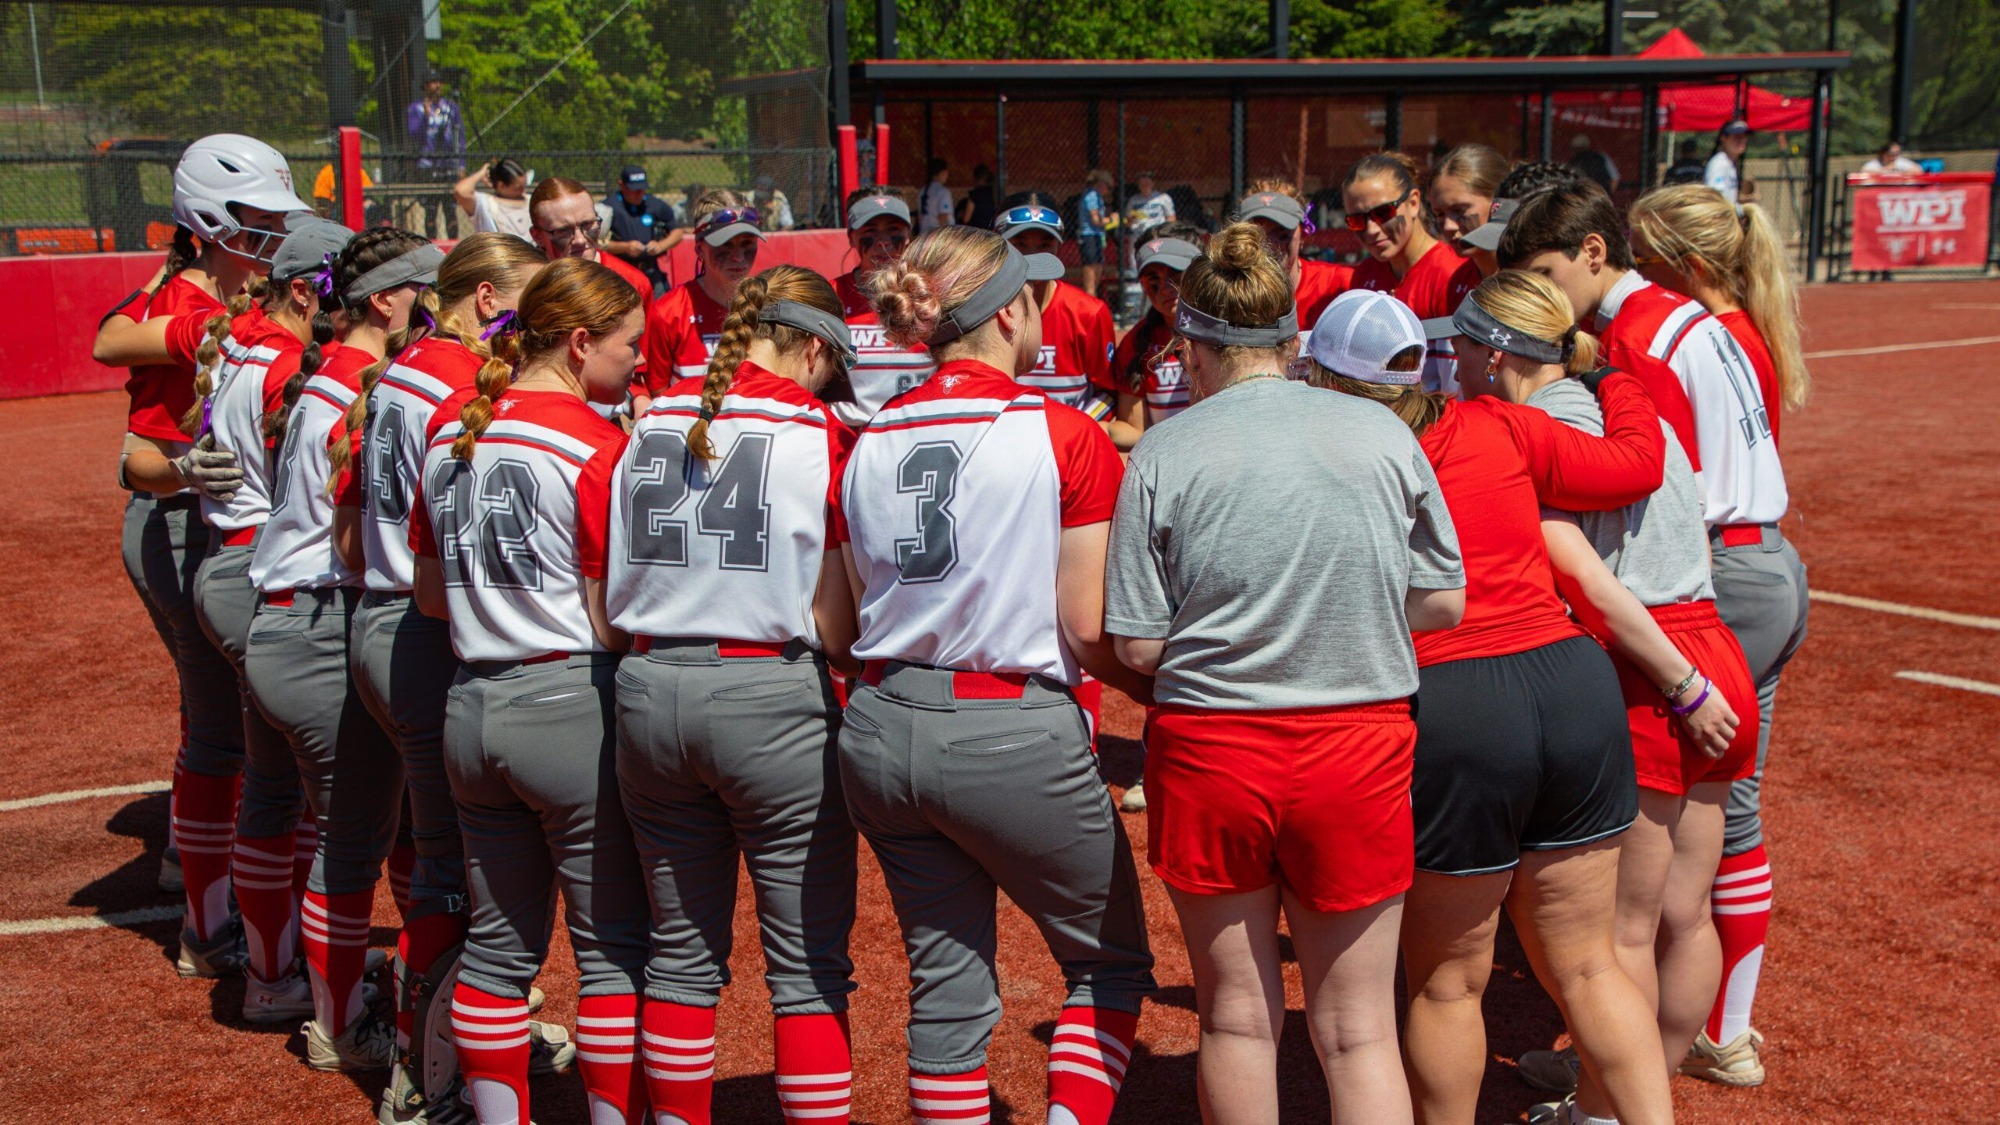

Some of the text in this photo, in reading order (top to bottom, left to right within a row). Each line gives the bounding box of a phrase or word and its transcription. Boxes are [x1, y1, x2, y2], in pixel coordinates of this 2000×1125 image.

[1877, 196, 1966, 226] WPI
[1708, 326, 1772, 450] 11
[431, 457, 544, 592] 22
[627, 428, 775, 572] 24
[894, 439, 964, 585] 3
